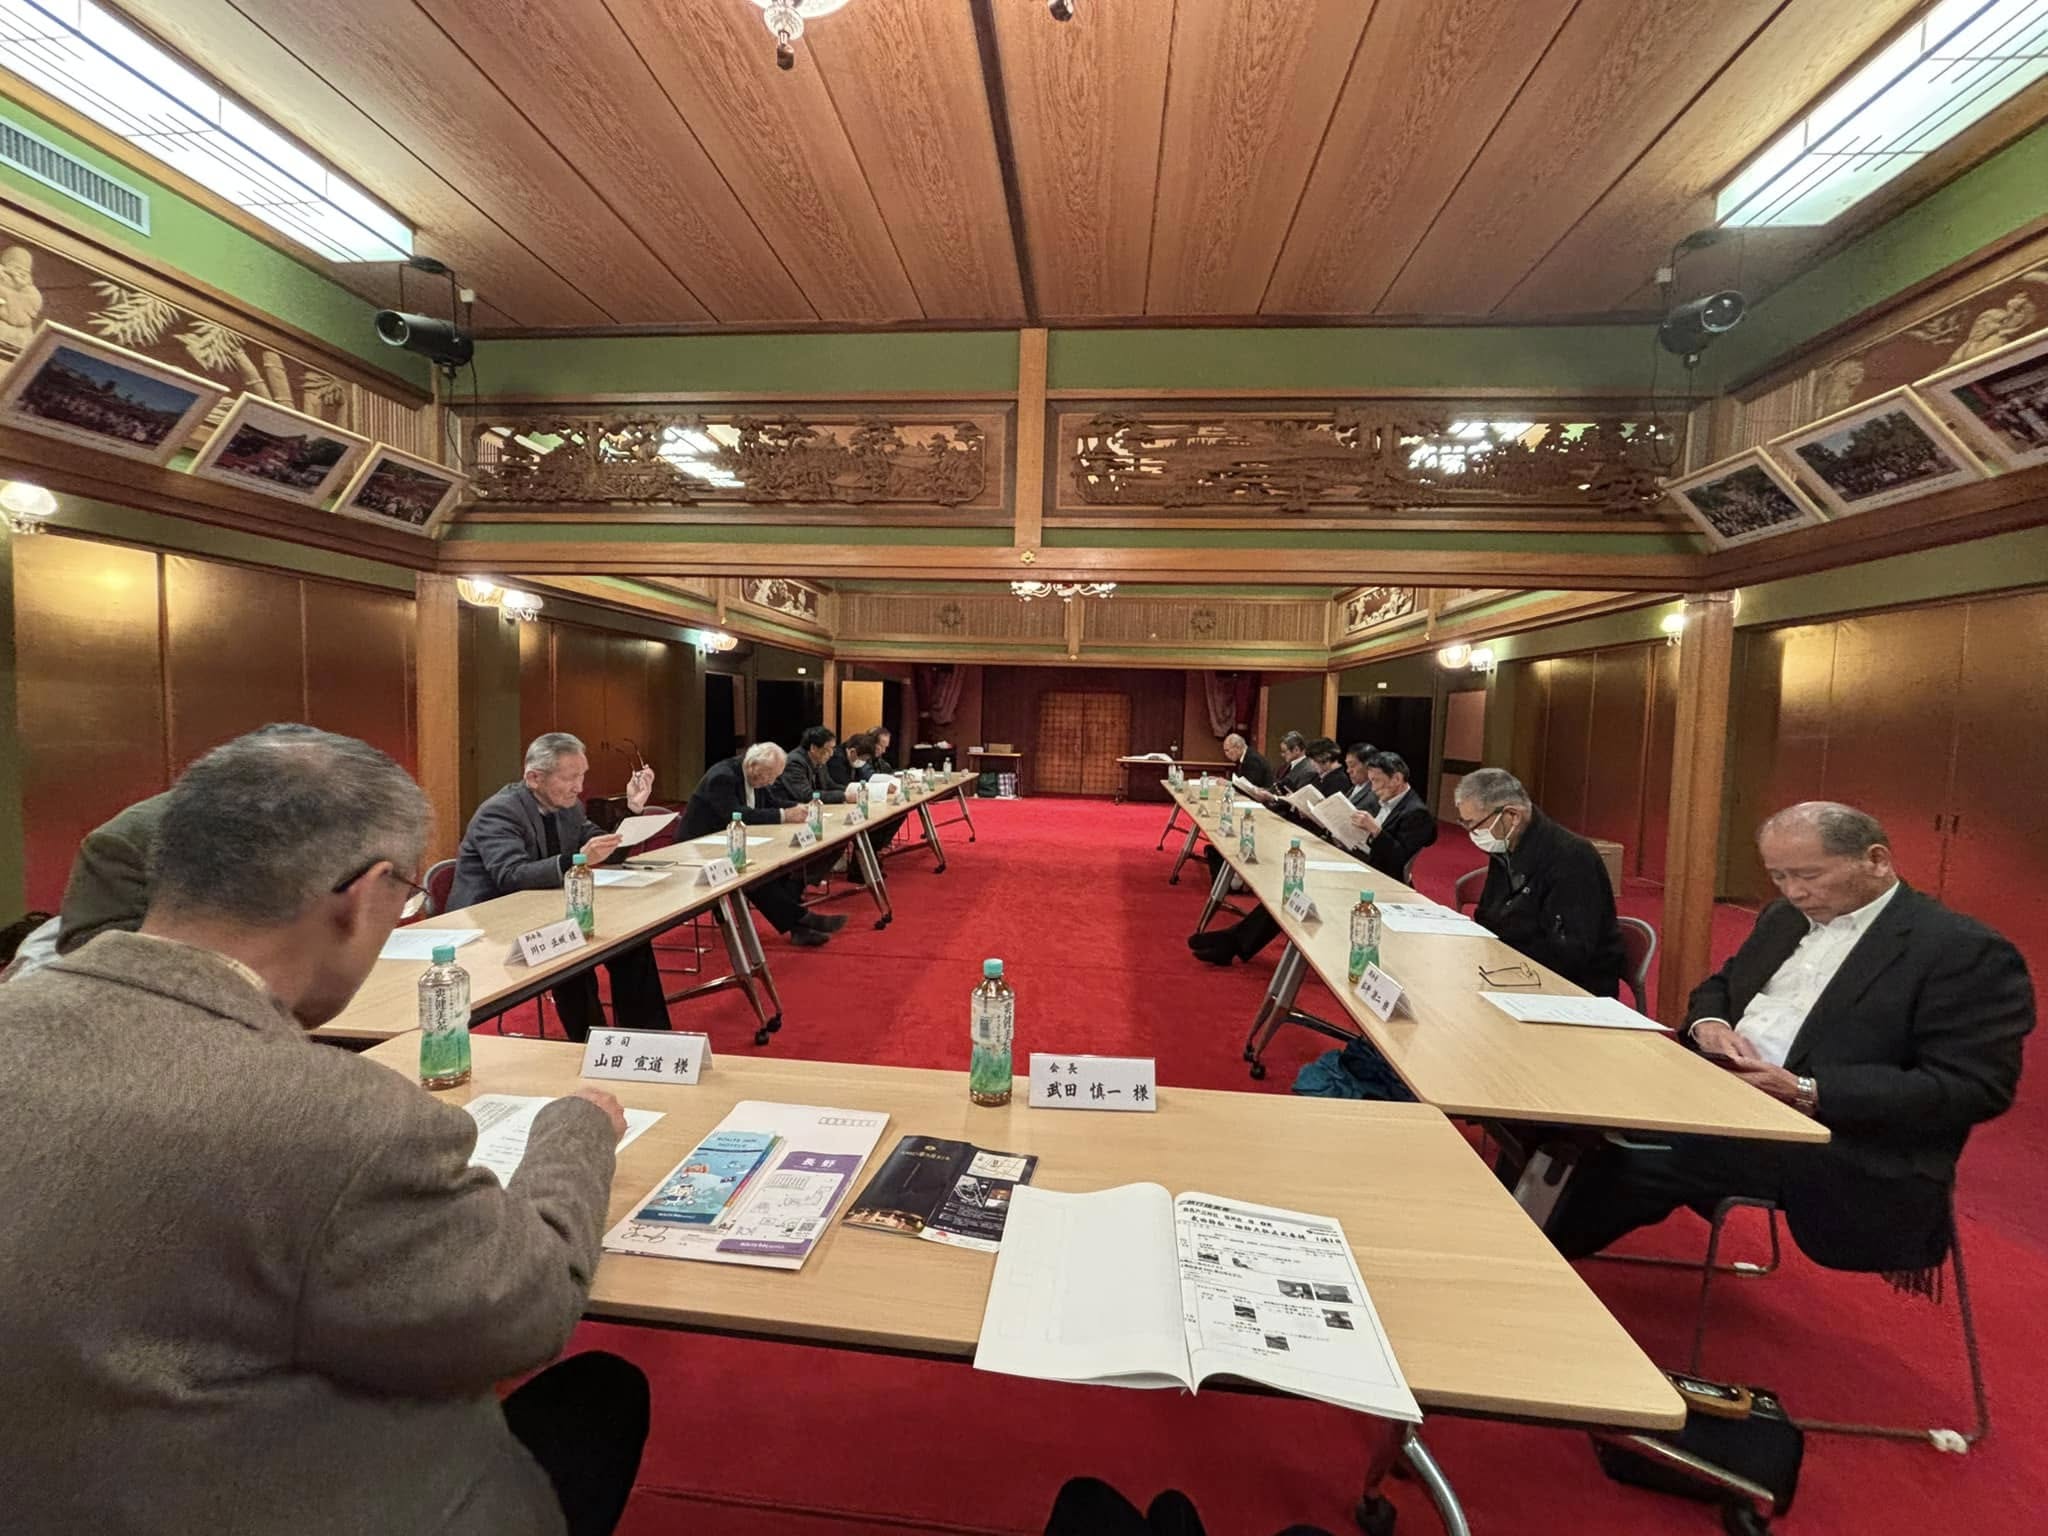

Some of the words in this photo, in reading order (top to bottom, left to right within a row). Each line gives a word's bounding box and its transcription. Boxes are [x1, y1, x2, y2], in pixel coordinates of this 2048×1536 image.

[594, 1053, 624, 1068] 山田
[674, 1058, 689, 1075] 様
[1049, 1062, 1078, 1075] 会長
[1046, 1081, 1077, 1099] 武田
[1132, 1084, 1149, 1102] 様
[801, 1157, 837, 1168] 長野
